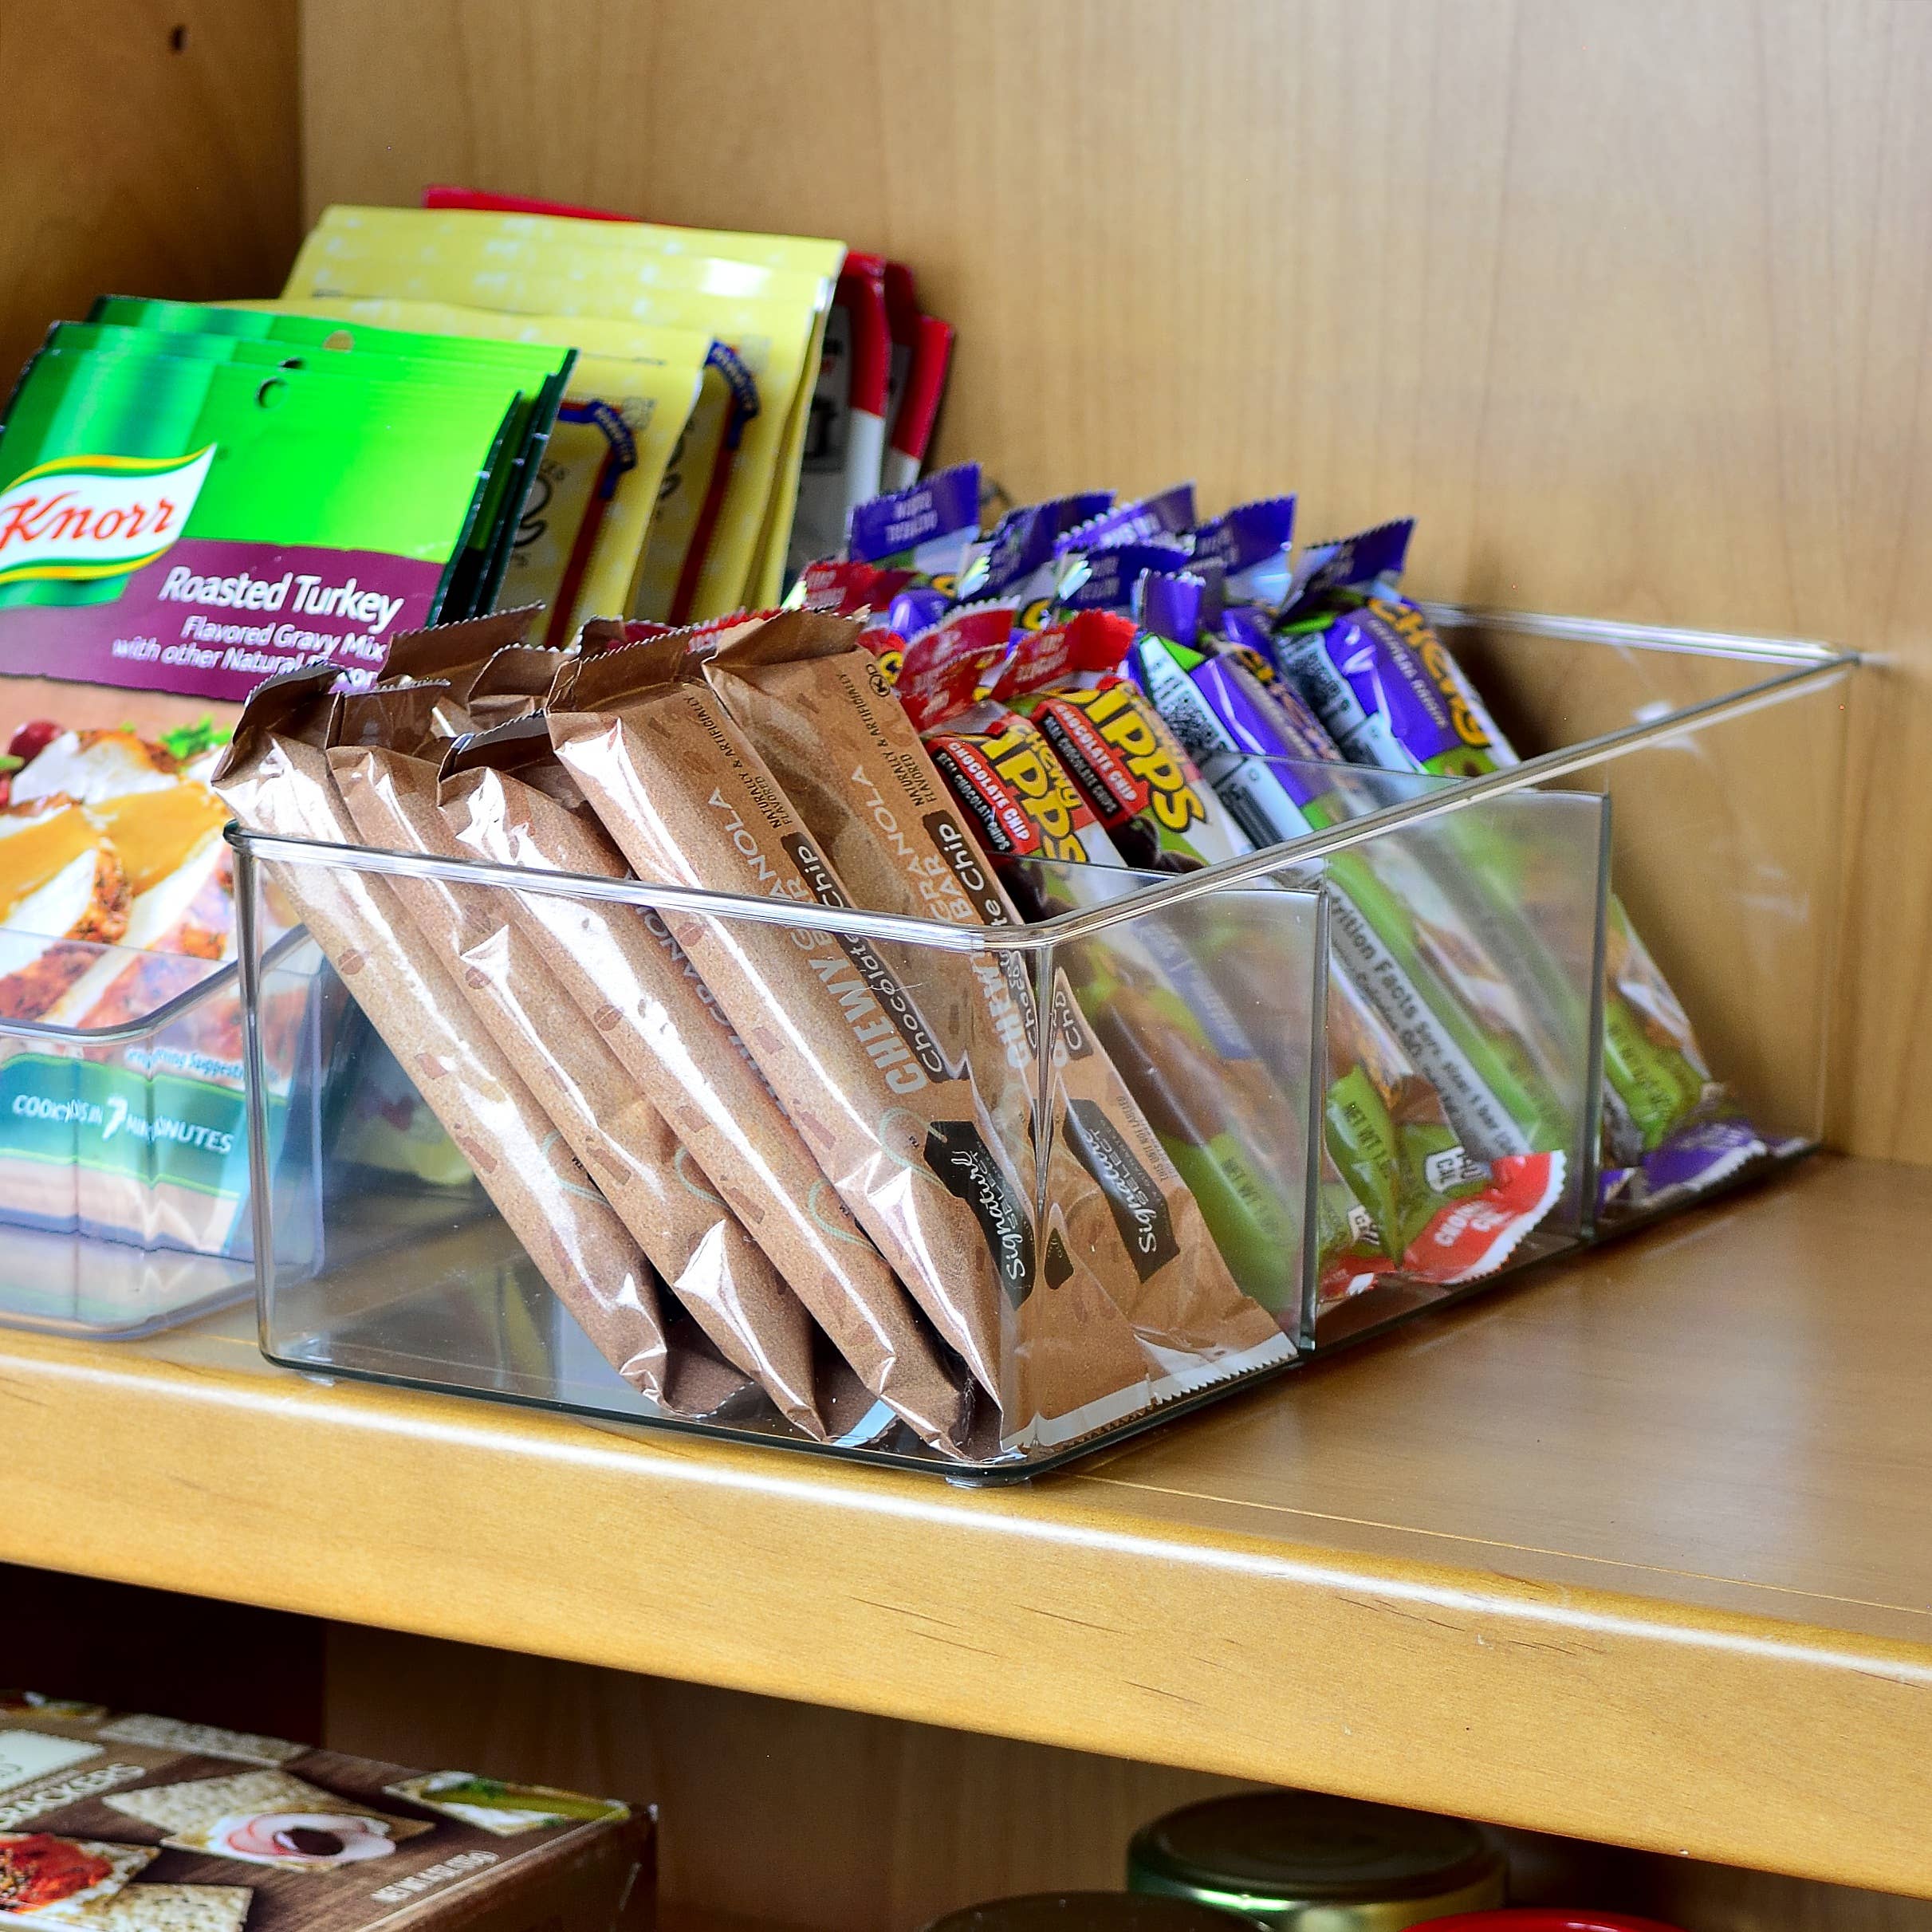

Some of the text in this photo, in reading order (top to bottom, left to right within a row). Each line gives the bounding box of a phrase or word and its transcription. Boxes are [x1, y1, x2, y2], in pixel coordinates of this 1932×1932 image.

[0, 490, 175, 549] Knorr
[159, 565, 404, 634] Roasted Turkey
[112, 635, 159, 659] with
[161, 643, 218, 669] other
[218, 647, 305, 675] Natural
[181, 614, 388, 663] Flavored Gravy Mix
[683, 696, 736, 757] ARTIFICIALLY
[837, 674, 880, 737] ARTIFICIALLY
[738, 771, 782, 829] NATURALLY
[754, 775, 793, 827] FLAVORED
[882, 751, 925, 807] NATURALLY
[899, 753, 938, 805] FLAVORED
[948, 742, 1031, 840] CHOCOLATE CHIP
[707, 786, 815, 951] GANOLA
[851, 765, 953, 923] GRANOLA
[938, 823, 985, 891] Chip
[923, 855, 973, 919] BAR
[797, 845, 943, 1073] Chocolate Chip
[809, 958, 927, 1095] CHEWY
[102, 1093, 128, 1141] 7
[970, 1150, 1018, 1230] SELECT
[1084, 1128, 1157, 1253] Signature
[1089, 1127, 1149, 1206] SELECT
[950, 1150, 1025, 1281] Signature
